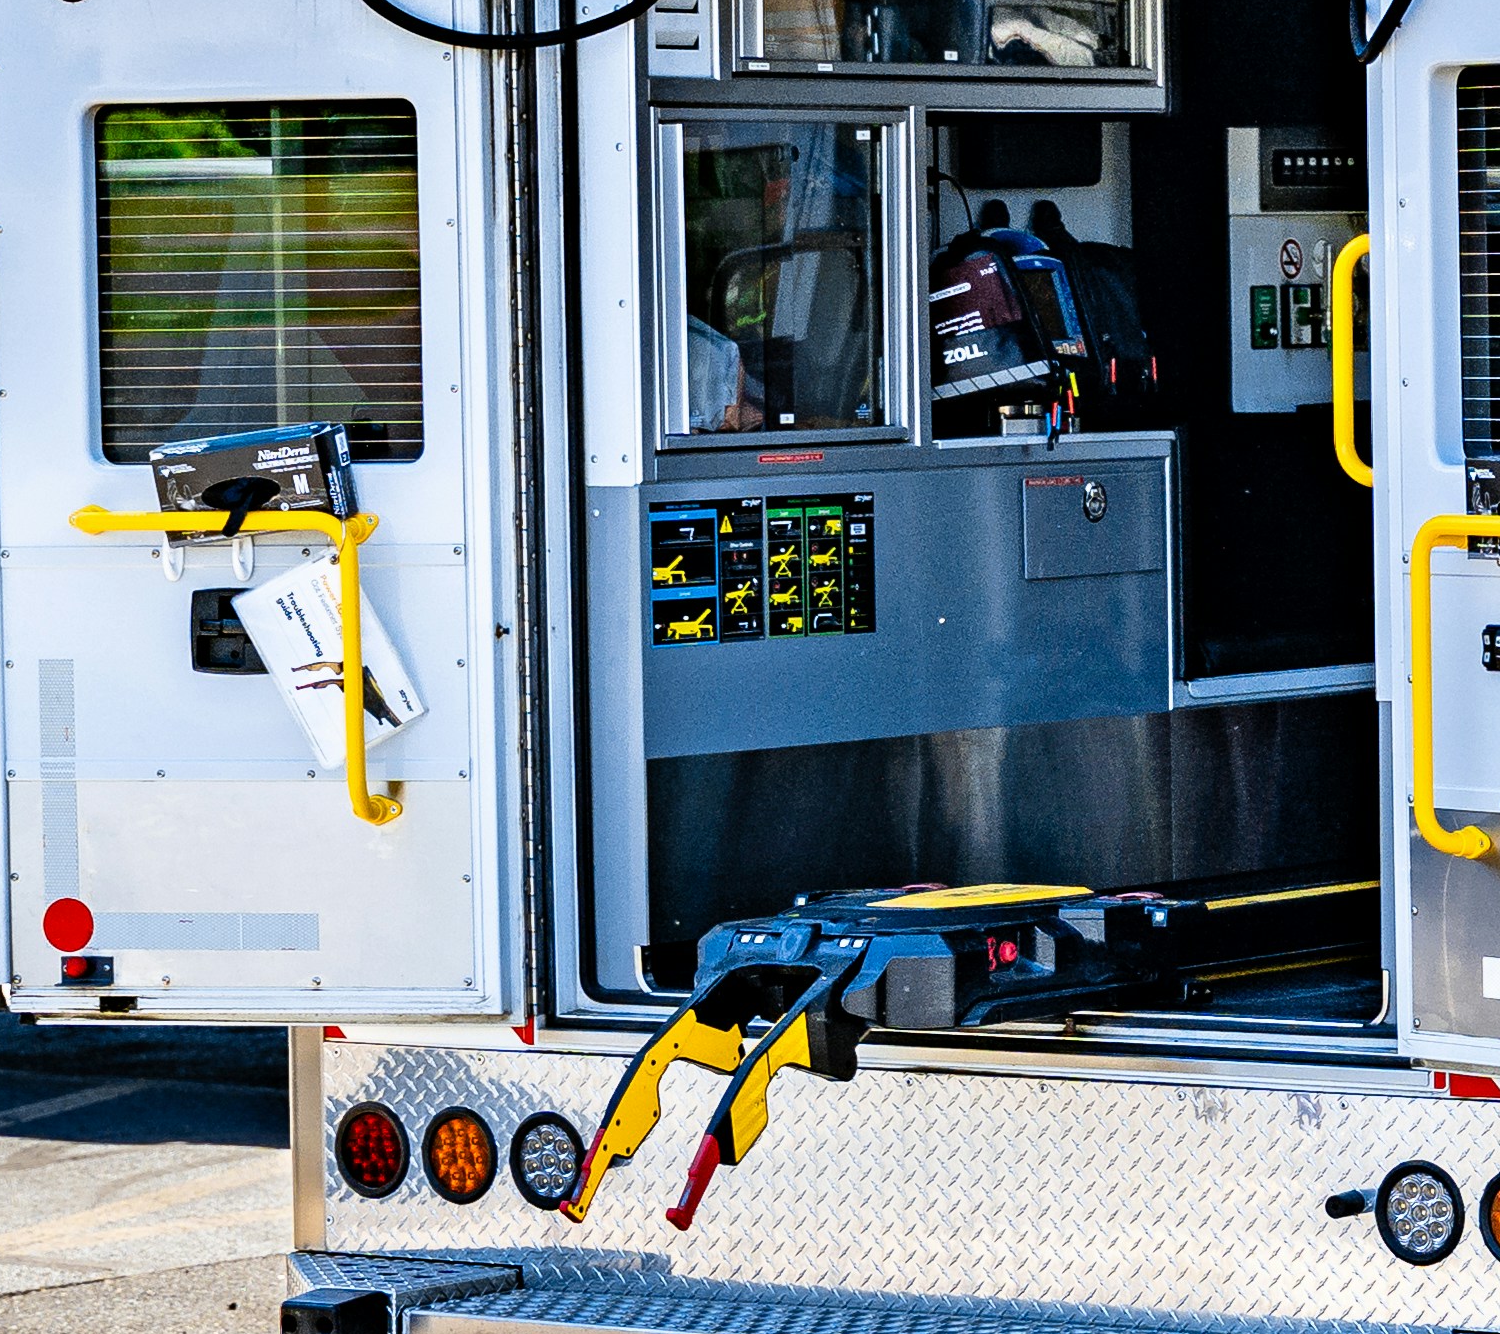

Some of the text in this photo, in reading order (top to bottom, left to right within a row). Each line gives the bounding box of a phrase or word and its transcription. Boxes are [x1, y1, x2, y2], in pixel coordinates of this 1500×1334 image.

[257, 446, 310, 461] NitriDerm
[292, 473, 310, 495] M
[275, 598, 293, 620] guide
[287, 591, 323, 657] Troubleshooting
[399, 689, 414, 712] stryker
